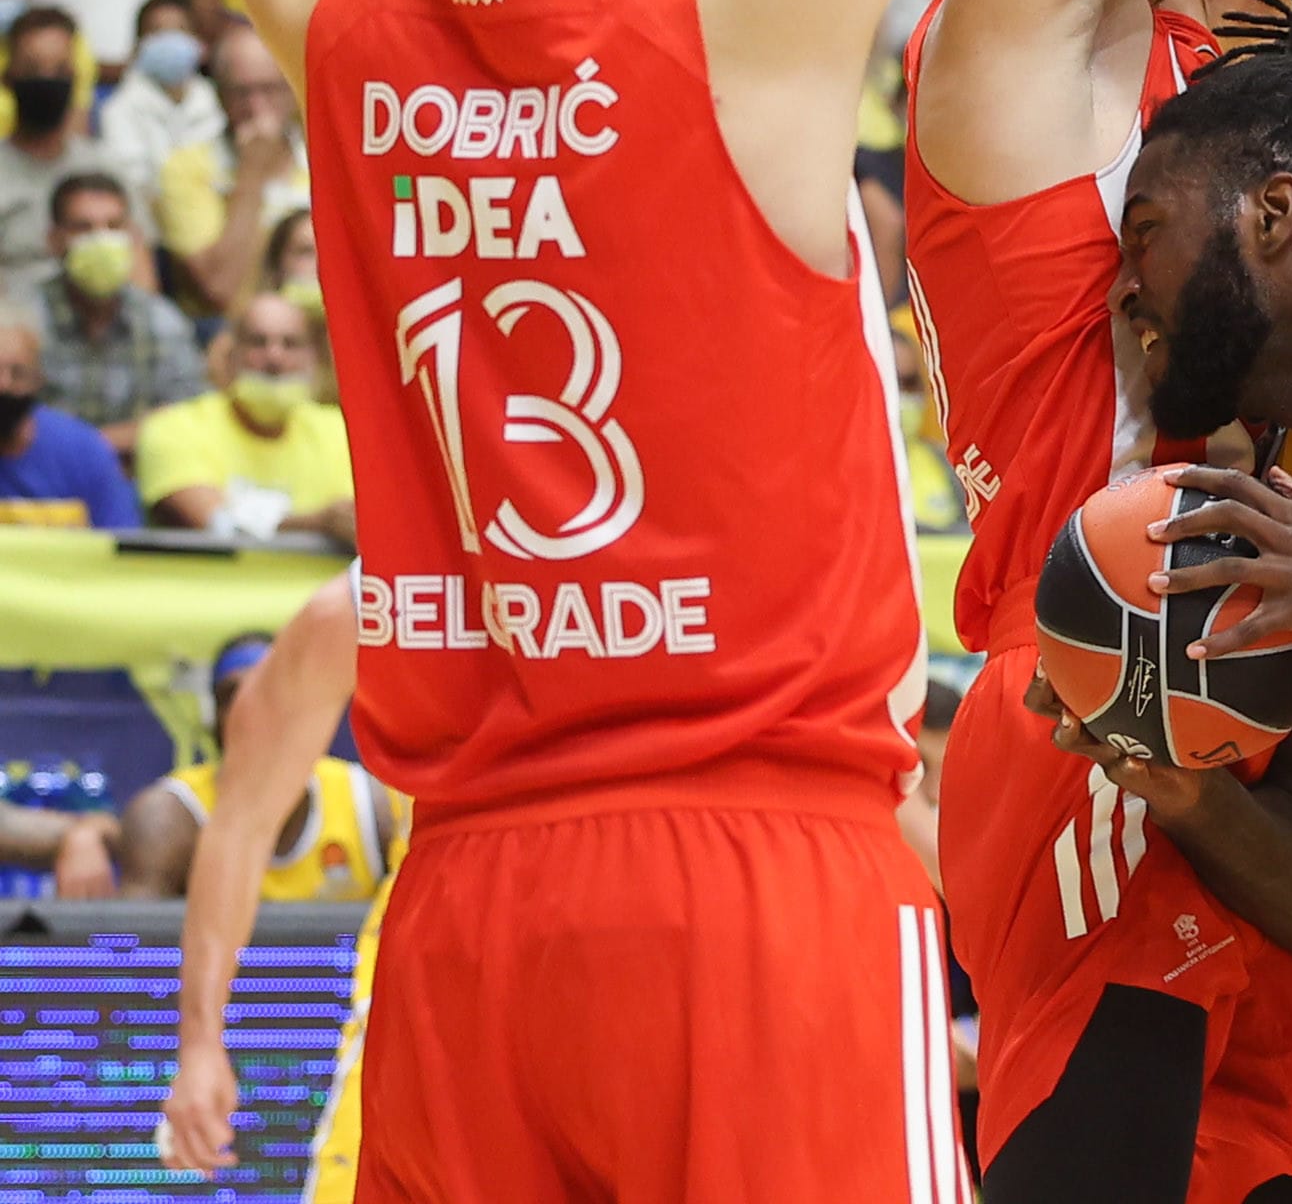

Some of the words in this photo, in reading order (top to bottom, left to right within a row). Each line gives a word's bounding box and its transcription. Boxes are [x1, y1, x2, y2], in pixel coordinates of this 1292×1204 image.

[362, 57, 620, 160] DOBRIĆ
[396, 277, 646, 561] 13
[358, 574, 717, 660] BELRADE
